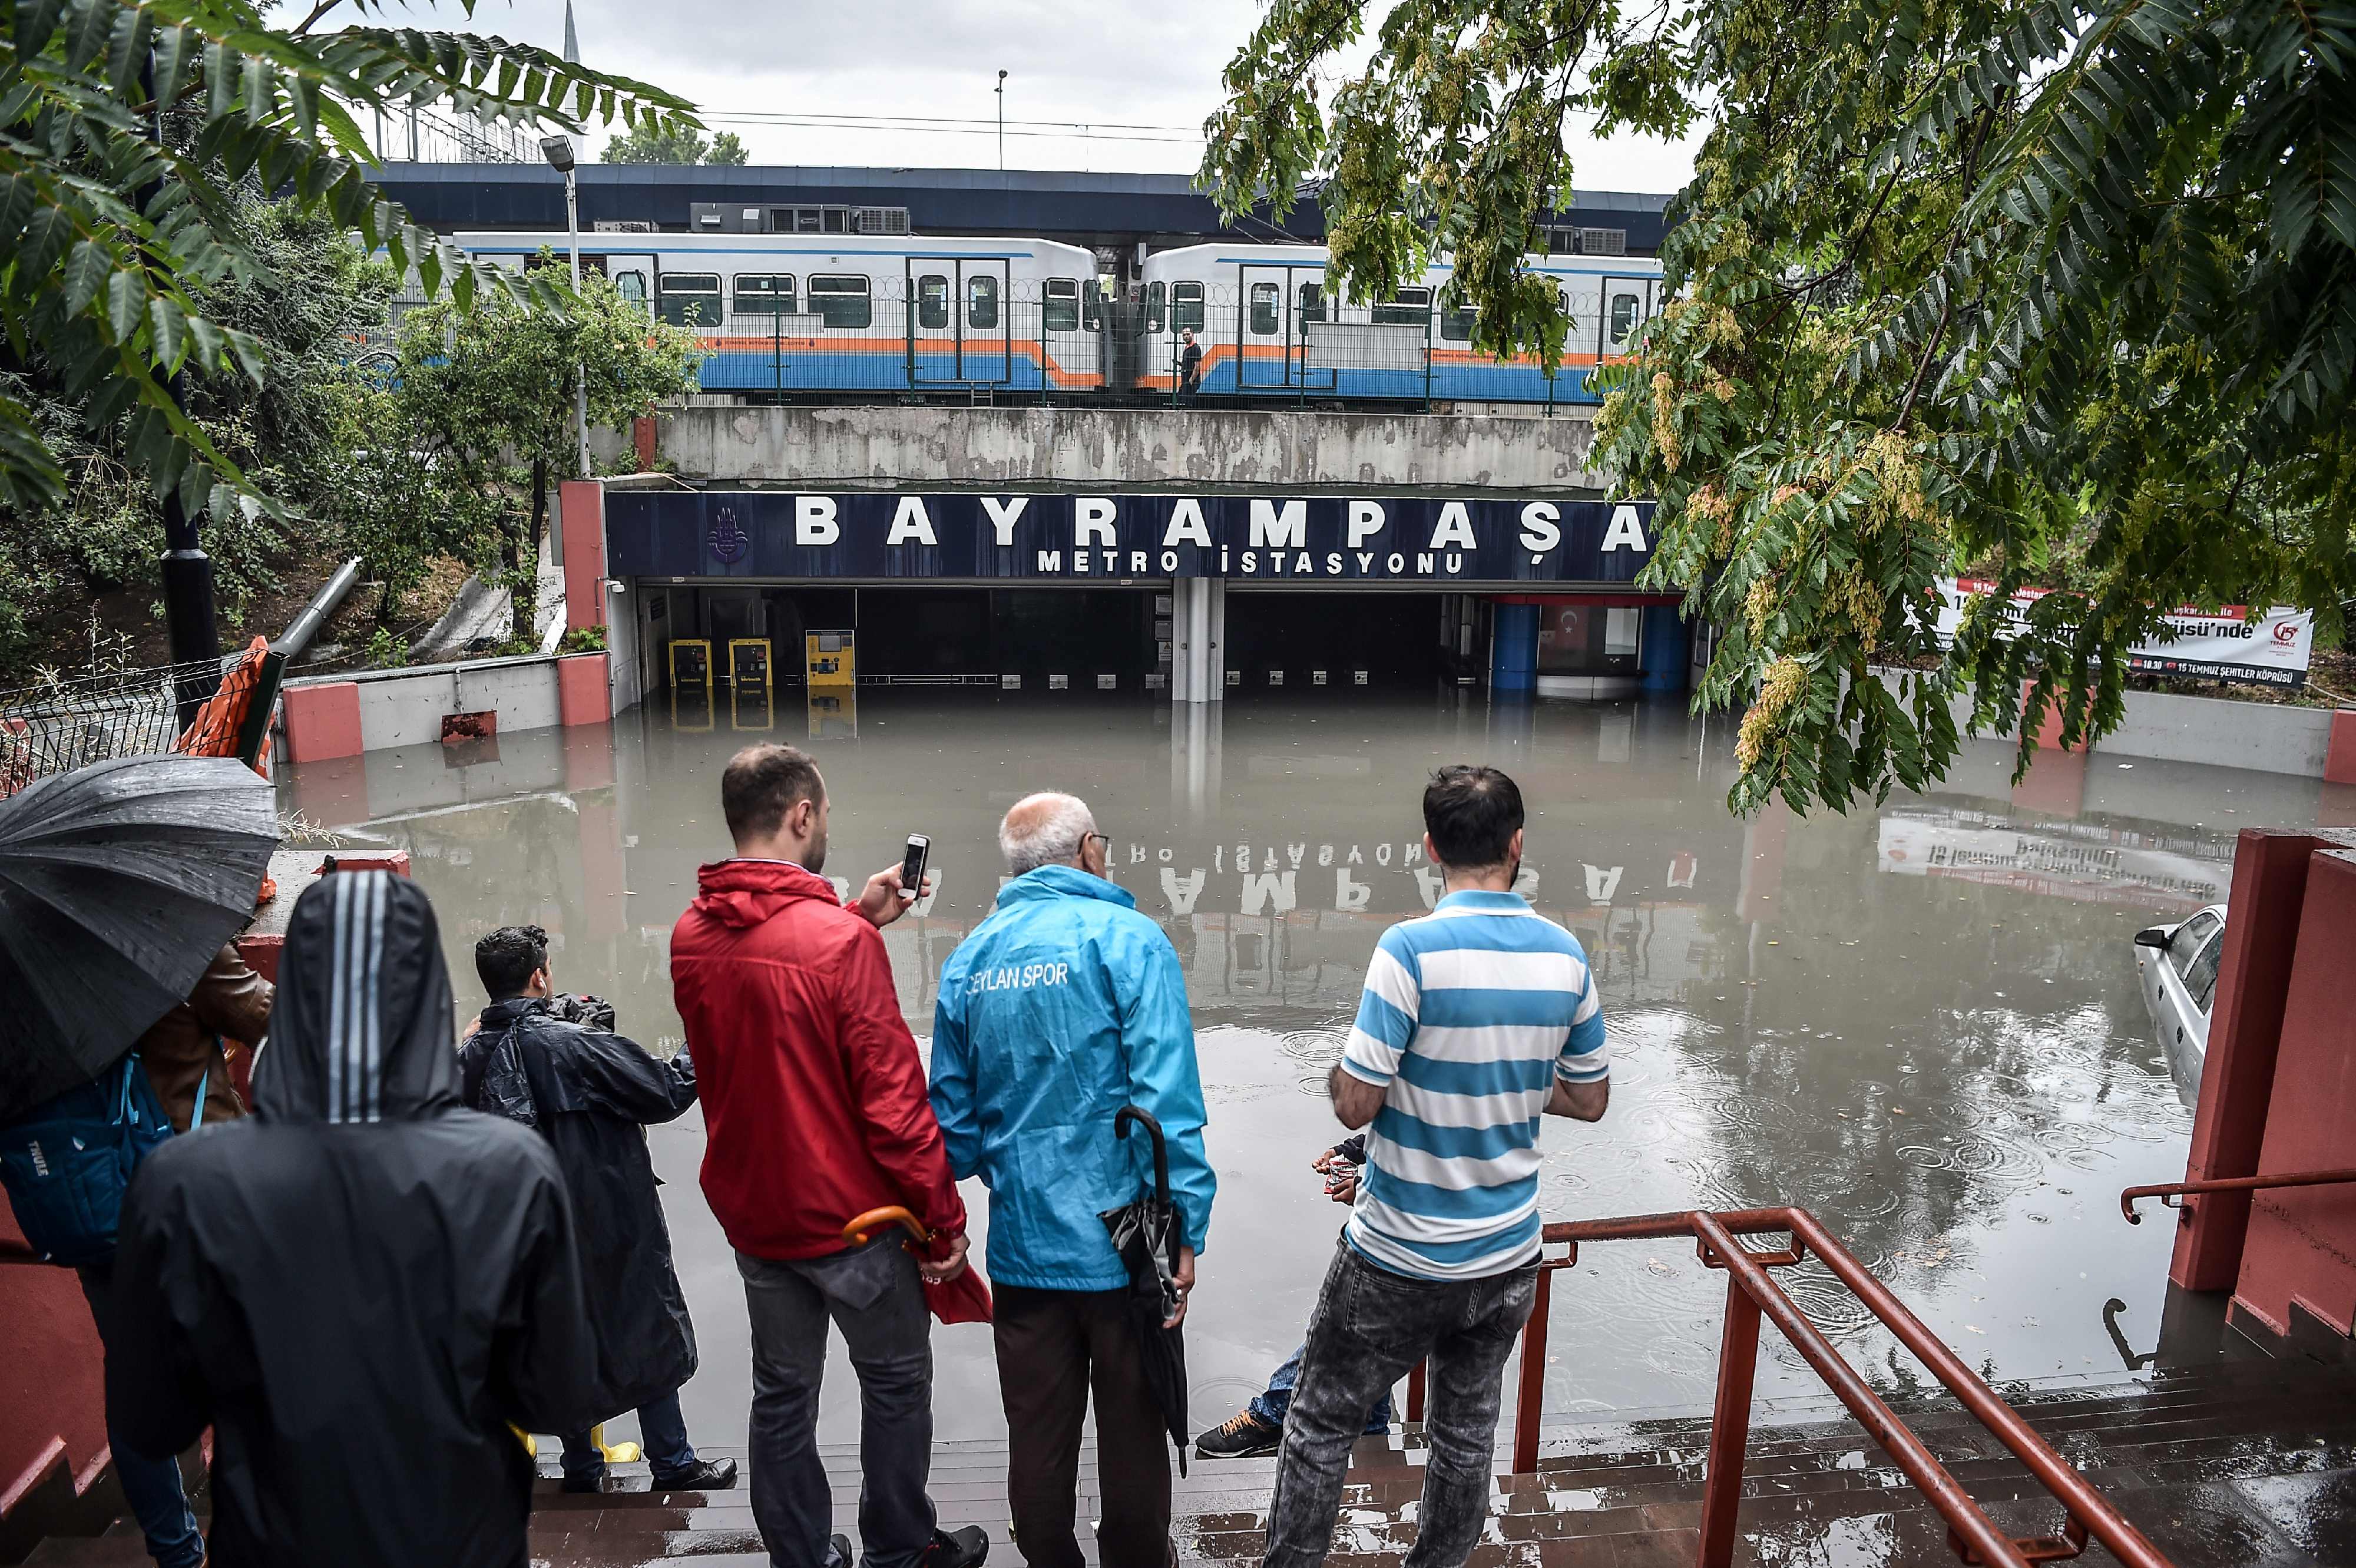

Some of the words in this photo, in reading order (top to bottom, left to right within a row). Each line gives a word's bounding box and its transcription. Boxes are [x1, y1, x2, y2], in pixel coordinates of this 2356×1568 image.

[795, 496, 1647, 565] BAYRAMPAŞA
[1038, 550, 1178, 573] METRO
[1221, 544, 1462, 574] İSTASYONU
[2179, 663, 2187, 672] 15
[2188, 664, 2219, 676] TEMMUZ
[2219, 667, 2255, 680] ŞEHİTLER
[2256, 669, 2293, 683] KÖPRÜSÜ
[965, 967, 1020, 995] CEYLAN
[1022, 962, 1068, 988] SPOR
